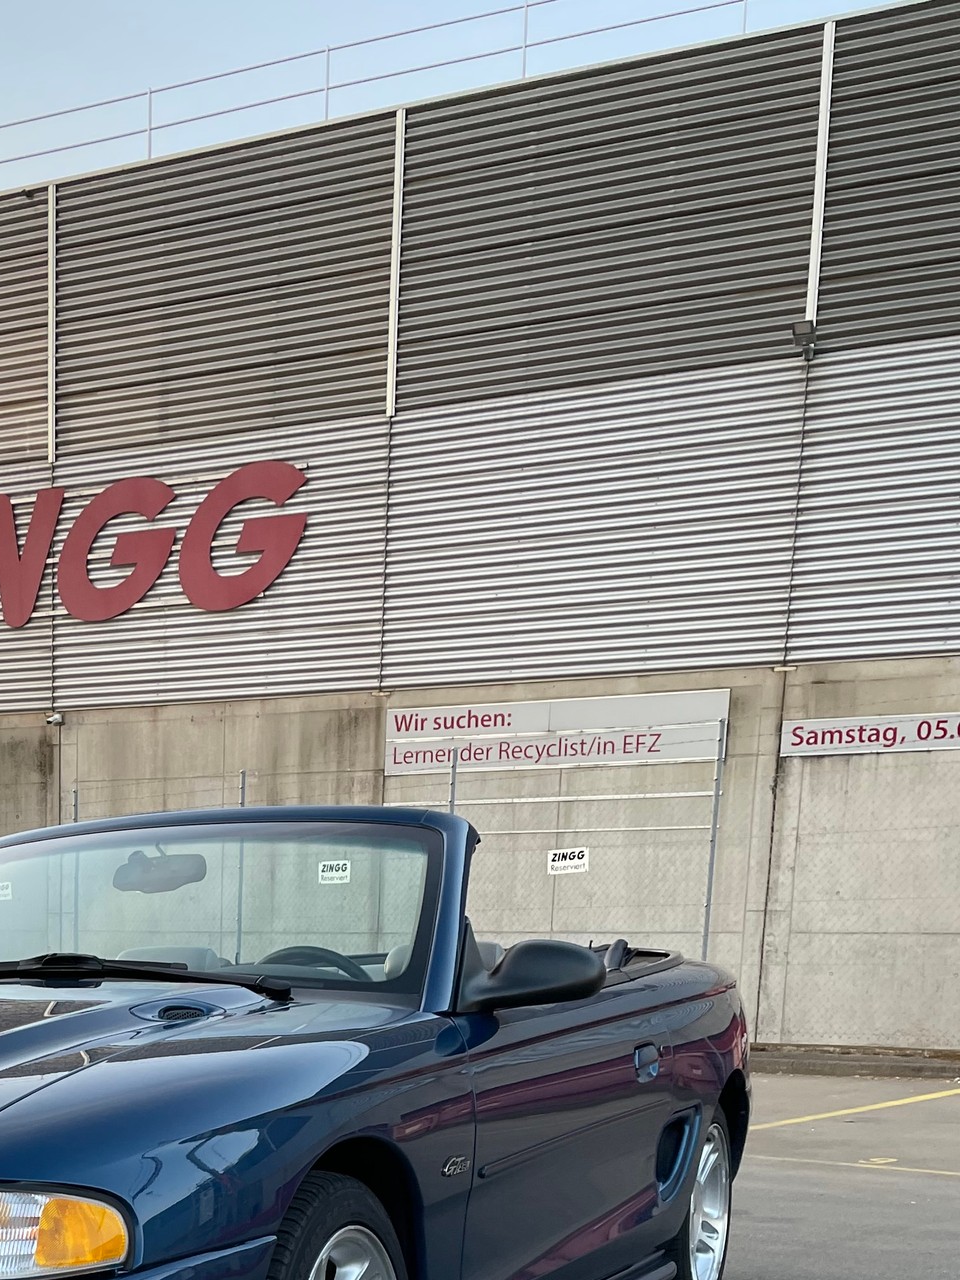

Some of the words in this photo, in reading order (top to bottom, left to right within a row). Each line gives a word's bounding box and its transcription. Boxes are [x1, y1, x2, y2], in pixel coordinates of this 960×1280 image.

[394, 712, 428, 732] Wir
[433, 710, 512, 731] suchen:
[791, 725, 906, 747] Samstag,
[916, 719, 960, 741] 05.
[498, 736, 615, 764] Recyclist/in
[622, 733, 662, 754] EFZ
[551, 850, 585, 862] ZINGG
[321, 863, 347, 873] ZINGG
[551, 863, 585, 872] Reserviert
